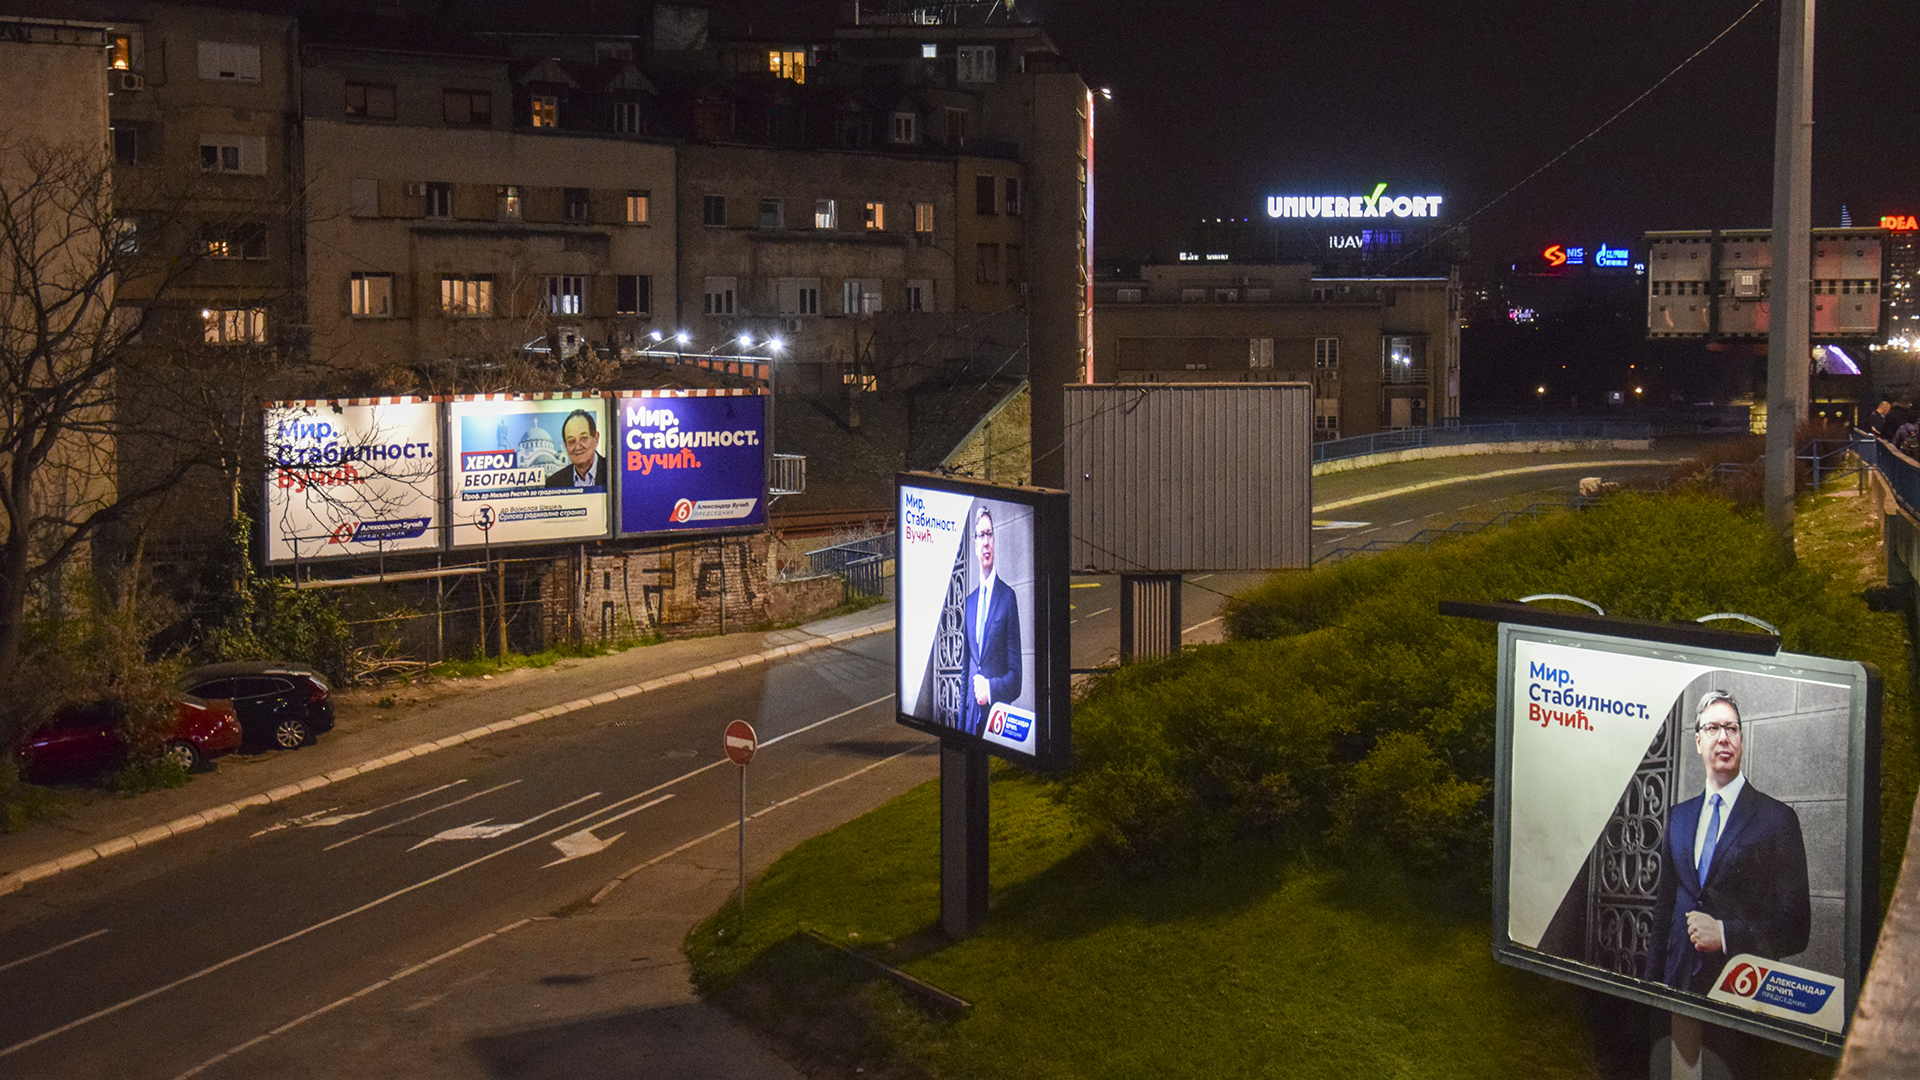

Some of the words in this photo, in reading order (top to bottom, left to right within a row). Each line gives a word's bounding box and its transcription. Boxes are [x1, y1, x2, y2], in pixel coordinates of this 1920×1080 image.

[1267, 183, 1443, 218] UNIVEREXPORT
[1566, 247, 1584, 258] NIS
[626, 406, 679, 431] Мир.
[278, 419, 338, 444] Мир.
[626, 427, 759, 450] Стабилност.
[277, 441, 433, 465] Стабилност.
[465, 453, 514, 470] ХЕРОЈ
[627, 447, 702, 475] Вучић.
[464, 470, 542, 487] БЕОГРАДА!
[678, 503, 687, 520] 6
[905, 493, 926, 513] Мир.
[479, 507, 491, 526] 3
[905, 510, 957, 532] Стабилност.
[905, 526, 935, 544] Вучић.
[1529, 660, 1574, 688] Мир.
[1529, 683, 1650, 720] Стабилност.
[994, 711, 1002, 734] 6
[1529, 702, 1594, 732] Вучић.
[1735, 966, 1754, 994] 6
[1765, 983, 1794, 997] ВУЧИЋ
[1769, 975, 1826, 997] АЛЕКСАНДАР
[1761, 990, 1807, 1009] ПРЕДСЕДНИК
